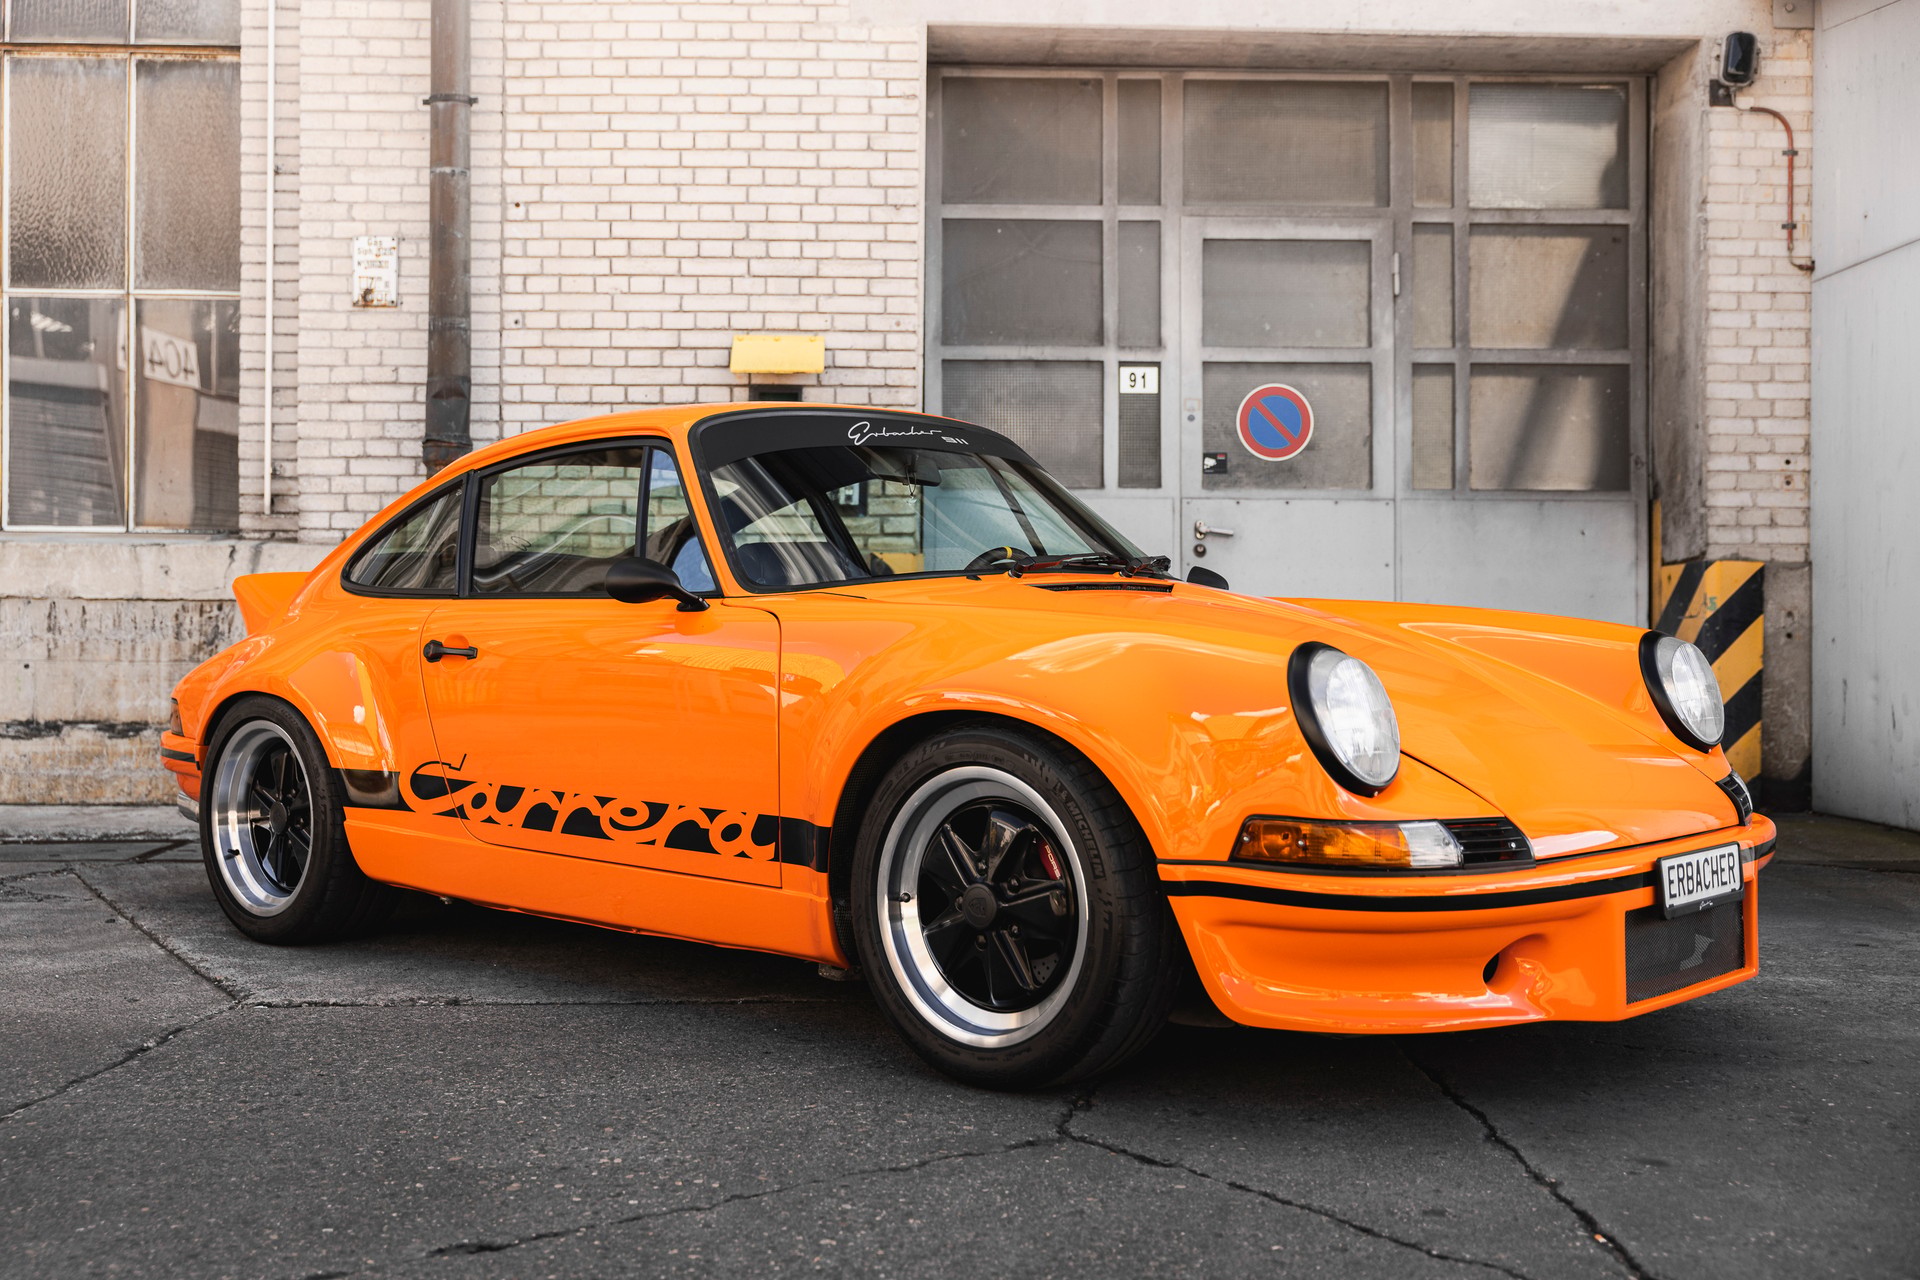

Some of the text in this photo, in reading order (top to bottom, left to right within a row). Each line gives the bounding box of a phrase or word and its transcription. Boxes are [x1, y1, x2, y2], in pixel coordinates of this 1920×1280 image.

[1129, 372, 1146, 389] 91
[847, 421, 969, 446] Erbacher 911
[398, 753, 776, 861] Carrera
[1066, 799, 1105, 878] MICHELIN
[1044, 844, 1061, 880] PORS
[1667, 852, 1736, 899] ERBACHER
